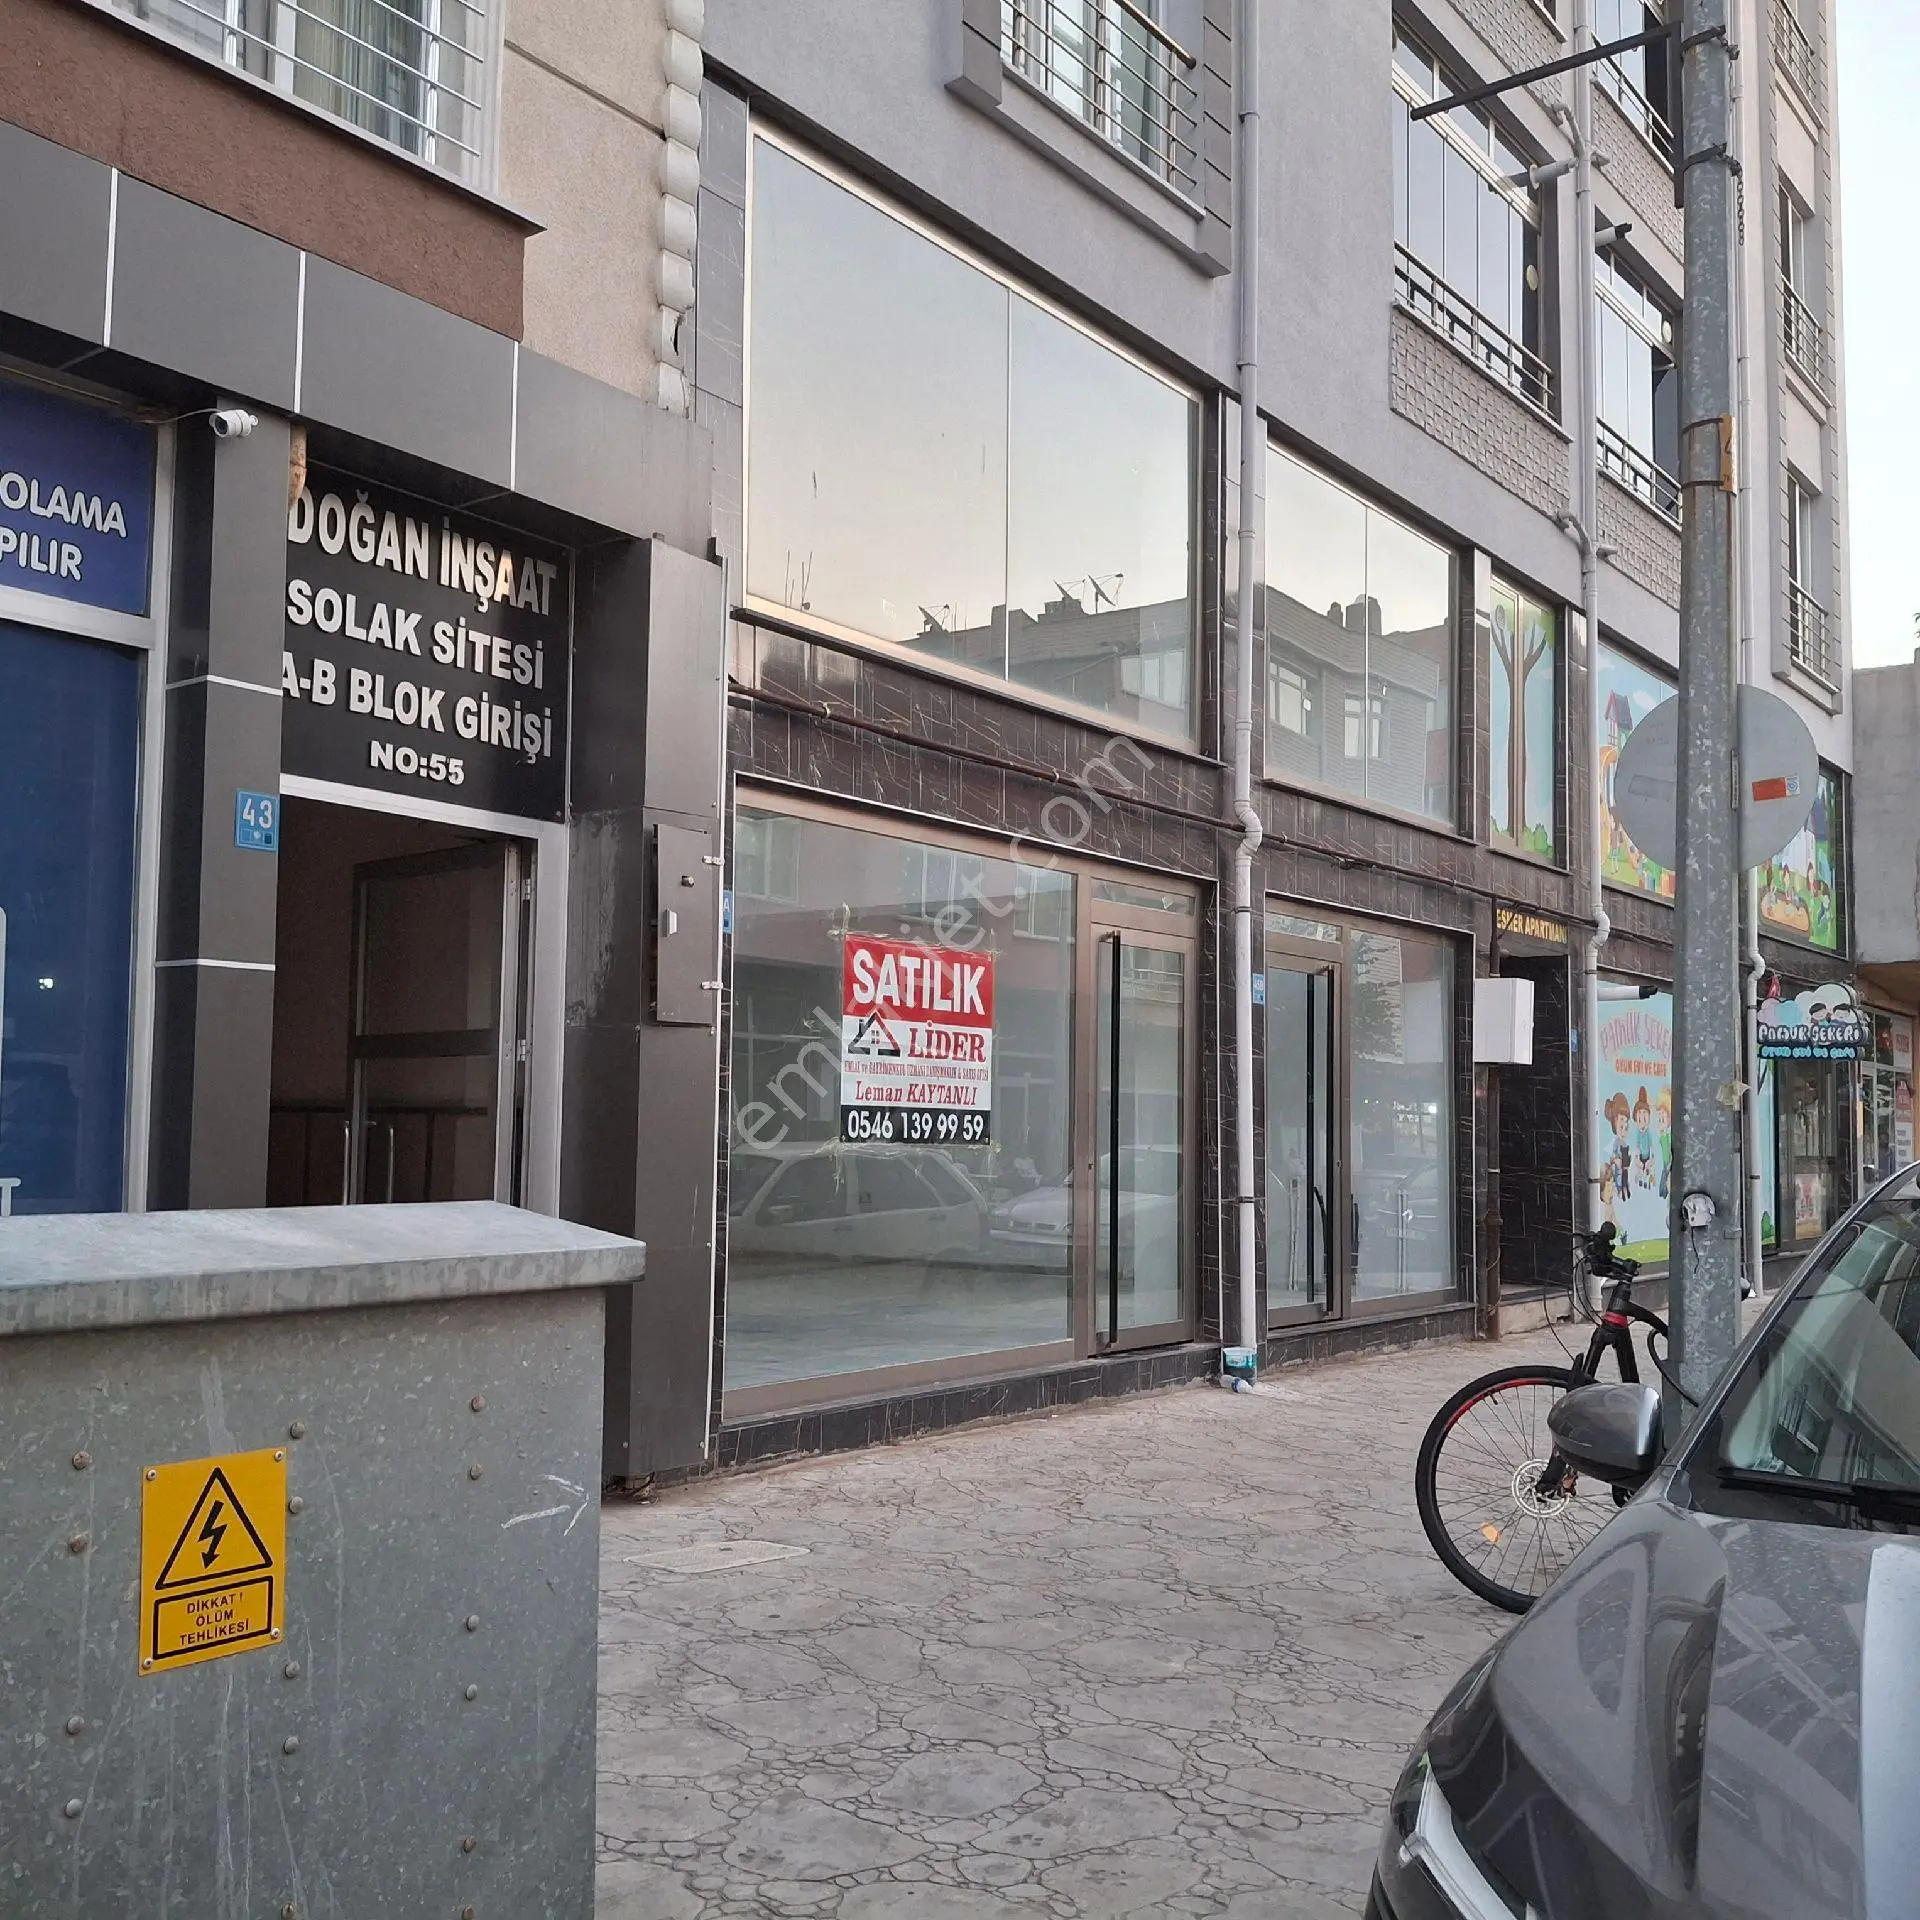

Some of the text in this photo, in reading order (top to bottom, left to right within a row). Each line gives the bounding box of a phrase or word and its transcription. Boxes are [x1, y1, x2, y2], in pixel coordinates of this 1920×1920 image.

[0, 472, 127, 538] OLAMA
[0, 525, 83, 581] PILIR
[288, 486, 558, 617] DOĞAN İNŞAAT
[287, 578, 544, 691] SOLAK SİTESİ
[282, 651, 553, 764] A-B BLOK GİRİŞİ
[369, 741, 466, 786] NO:55
[243, 798, 272, 829] 43
[851, 948, 987, 1017] SATILIK
[908, 1020, 987, 1063] LİDER
[856, 1080, 978, 1106] Leman KAYTANLI
[847, 1109, 984, 1141] 0546 139 99 59
[187, 1595, 235, 1614] DİKKAT
[179, 1618, 250, 1646] TEHLİKESİ
